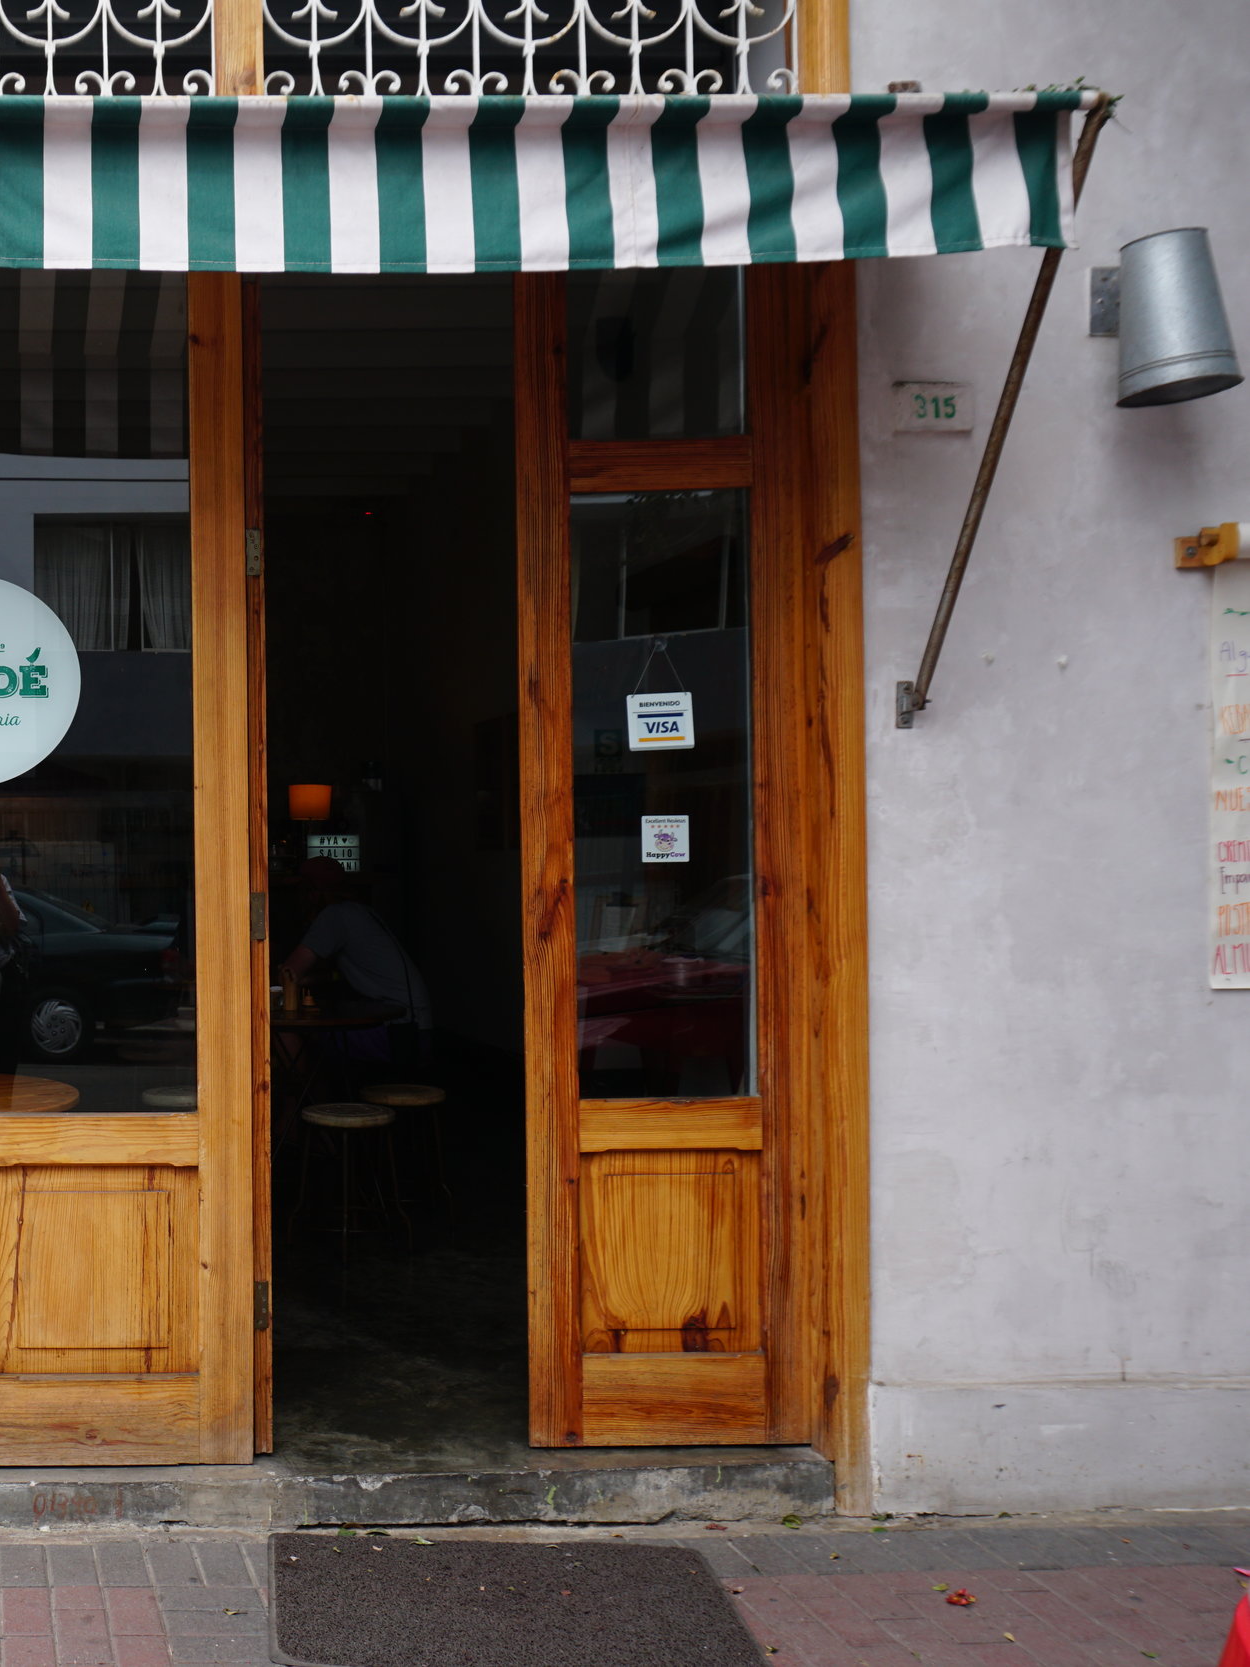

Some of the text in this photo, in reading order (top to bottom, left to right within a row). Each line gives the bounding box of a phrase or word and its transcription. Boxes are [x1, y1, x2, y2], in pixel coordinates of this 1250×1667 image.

[913, 394, 957, 418] 315
[639, 700, 680, 708] BIENVENIDO
[643, 721, 680, 734] VISA
[319, 836, 338, 845] #YA
[319, 849, 352, 858] SALIO
[646, 851, 686, 859] HappyCow
